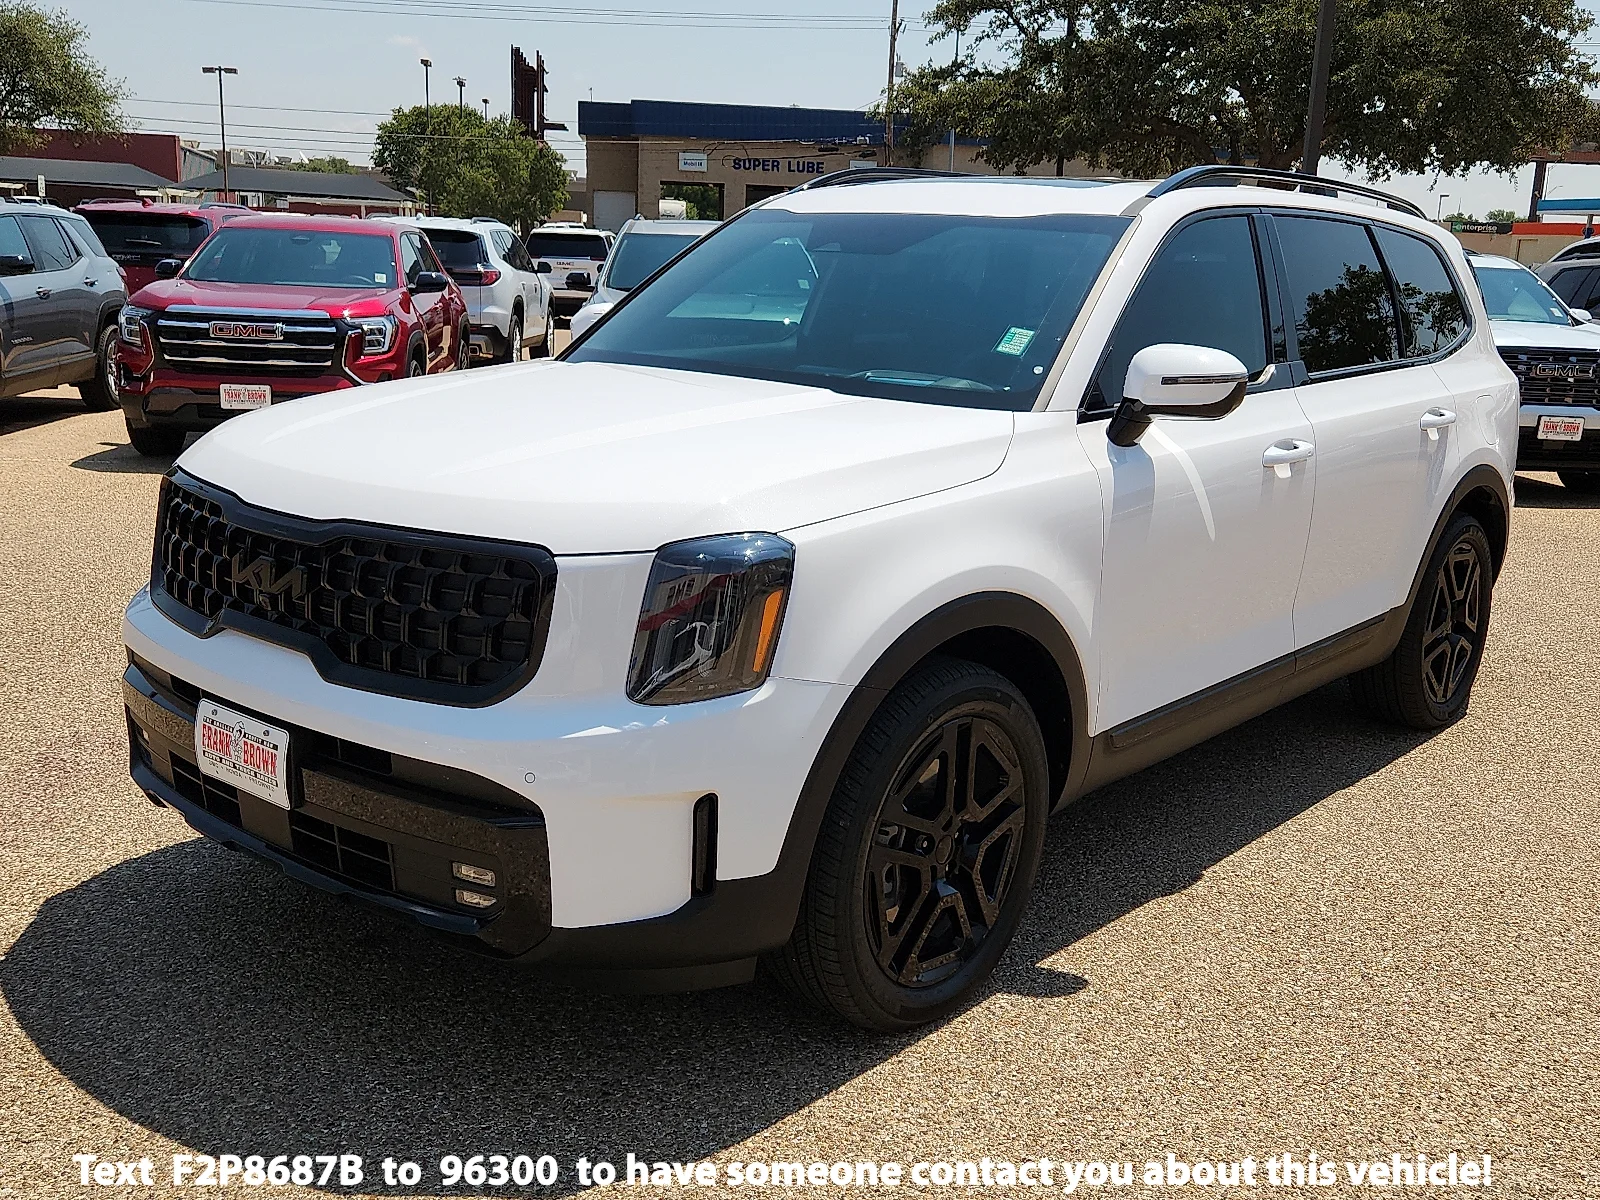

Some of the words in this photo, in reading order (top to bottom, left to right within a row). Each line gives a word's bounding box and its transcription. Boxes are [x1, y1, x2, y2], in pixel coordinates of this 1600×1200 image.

[732, 158, 780, 173] SUPER
[787, 159, 825, 174] LUBE
[1452, 223, 1498, 232] enterprise
[213, 323, 277, 338] GMC
[1537, 364, 1592, 377] GMC
[224, 391, 241, 400] FRANK
[247, 392, 267, 401] BROWN
[202, 723, 232, 758] FRANK
[243, 740, 278, 778] BROWN
